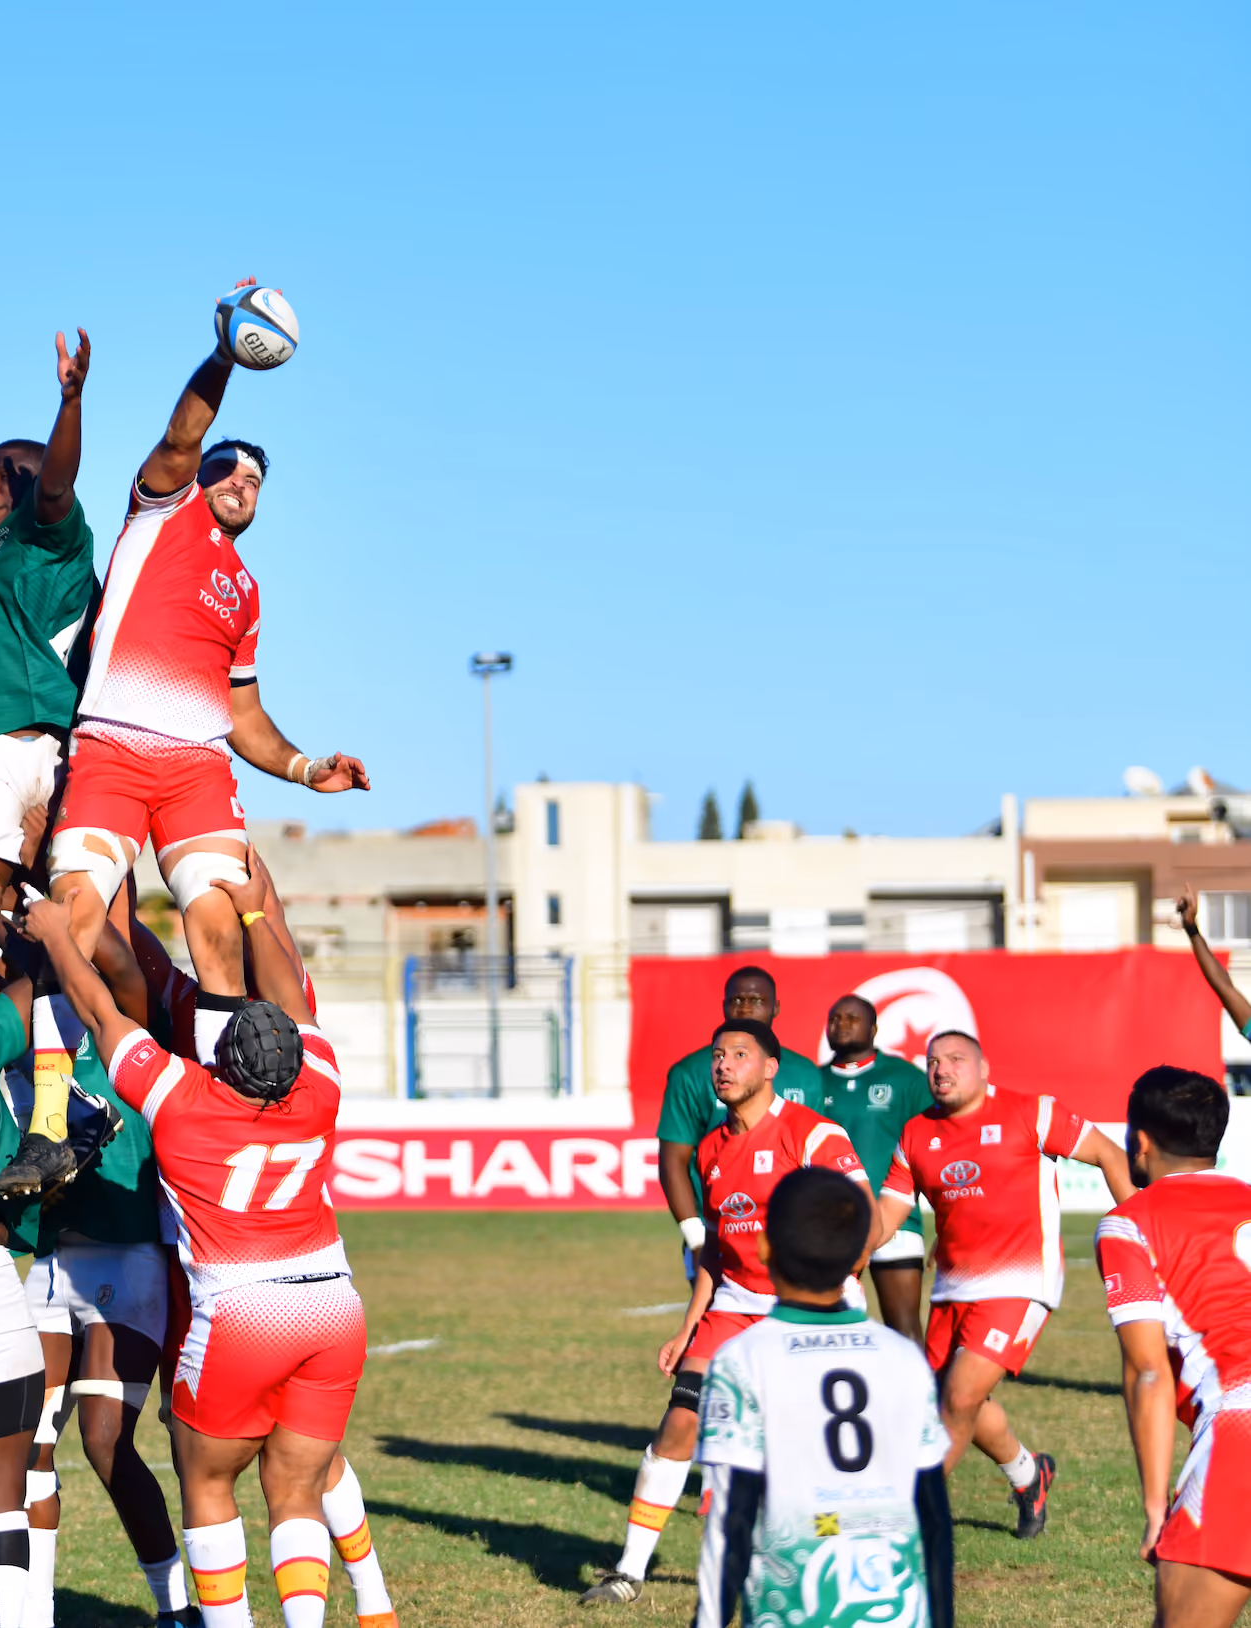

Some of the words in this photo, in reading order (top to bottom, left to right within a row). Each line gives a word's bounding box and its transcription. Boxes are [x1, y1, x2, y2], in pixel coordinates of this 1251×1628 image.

[218, 1135, 326, 1212] 17
[943, 1187, 984, 1200] TOYOTA
[790, 1333, 875, 1350] AMATEX
[821, 1368, 874, 1472] 8
